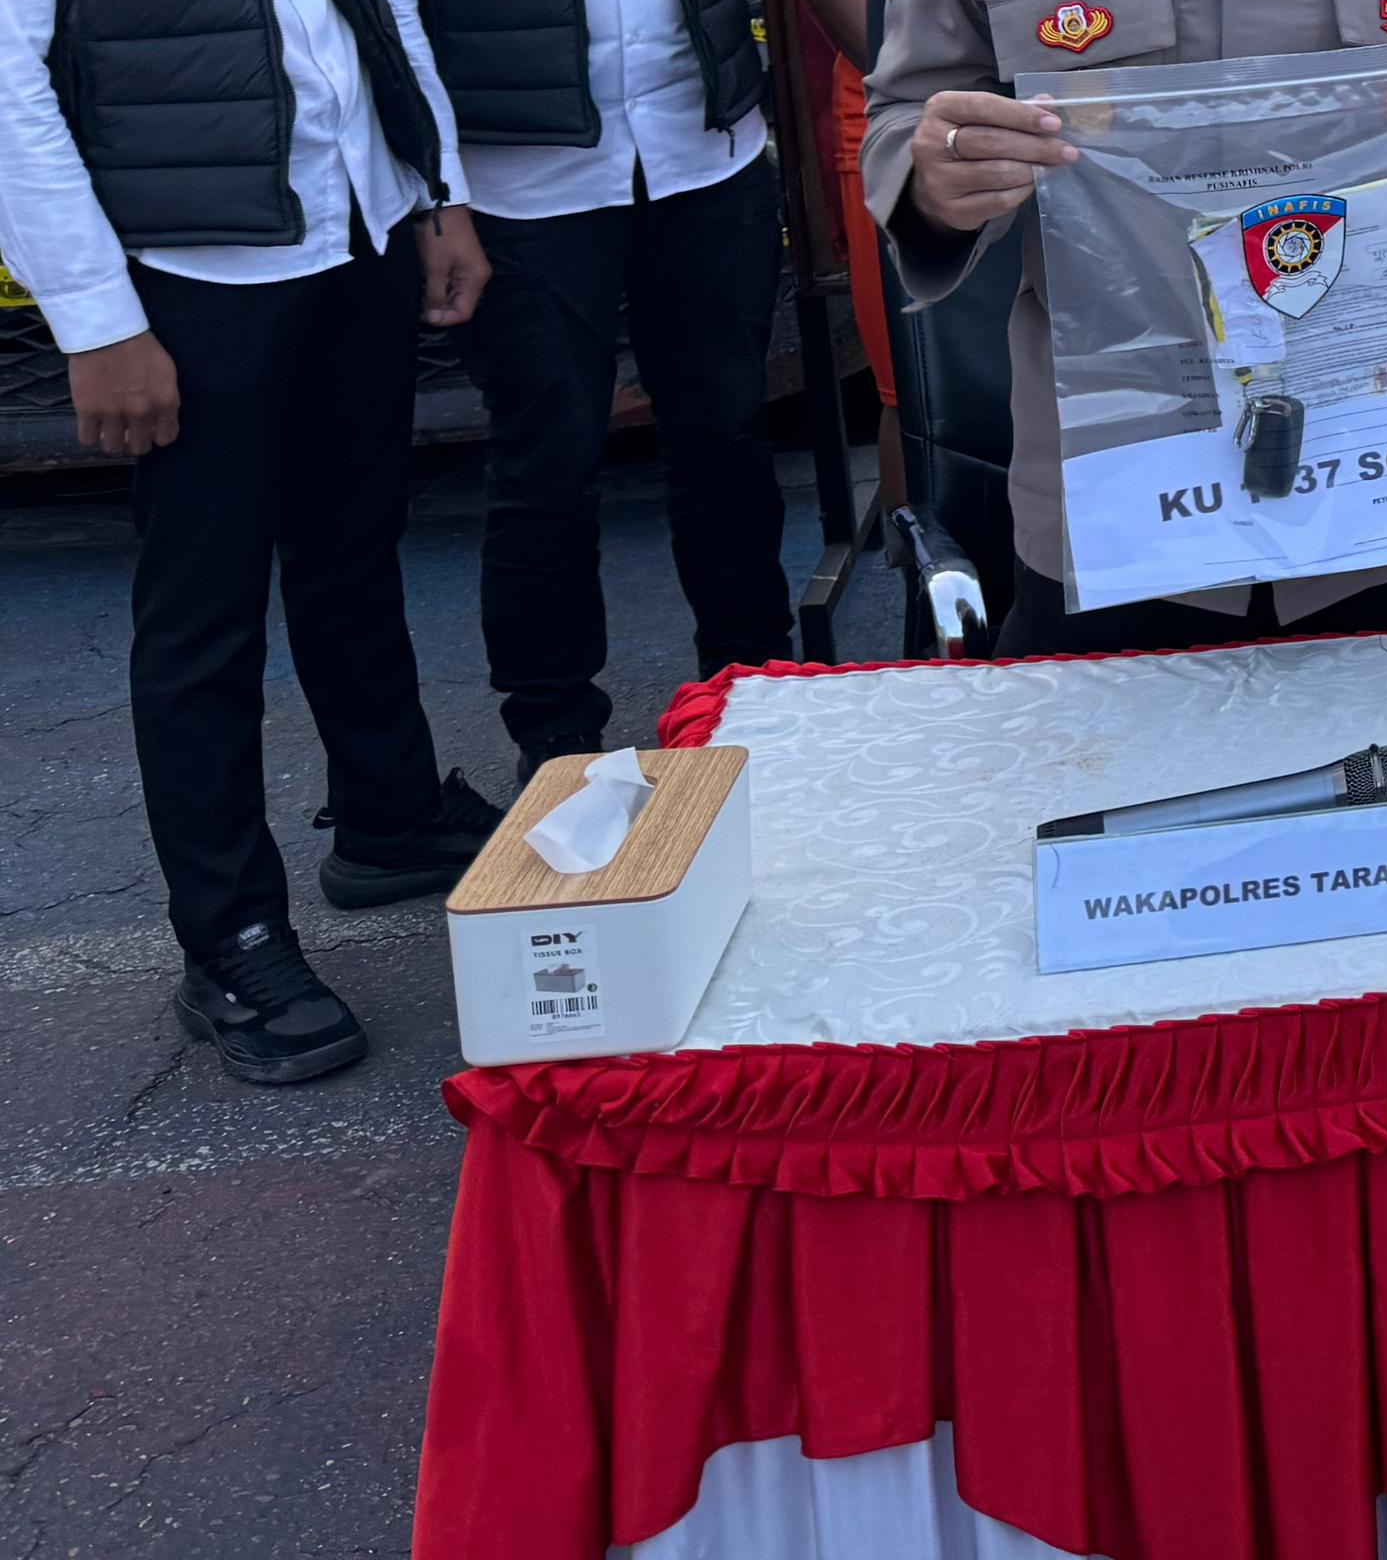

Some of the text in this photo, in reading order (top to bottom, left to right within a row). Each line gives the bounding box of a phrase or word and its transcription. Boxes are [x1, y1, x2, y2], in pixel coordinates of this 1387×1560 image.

[1257, 200, 1332, 219] INAFIS
[1159, 482, 1224, 522] KU
[1084, 874, 1301, 922] WAKAPOLRES
[531, 931, 584, 946] DIY
[533, 950, 561, 958] TISSUE
